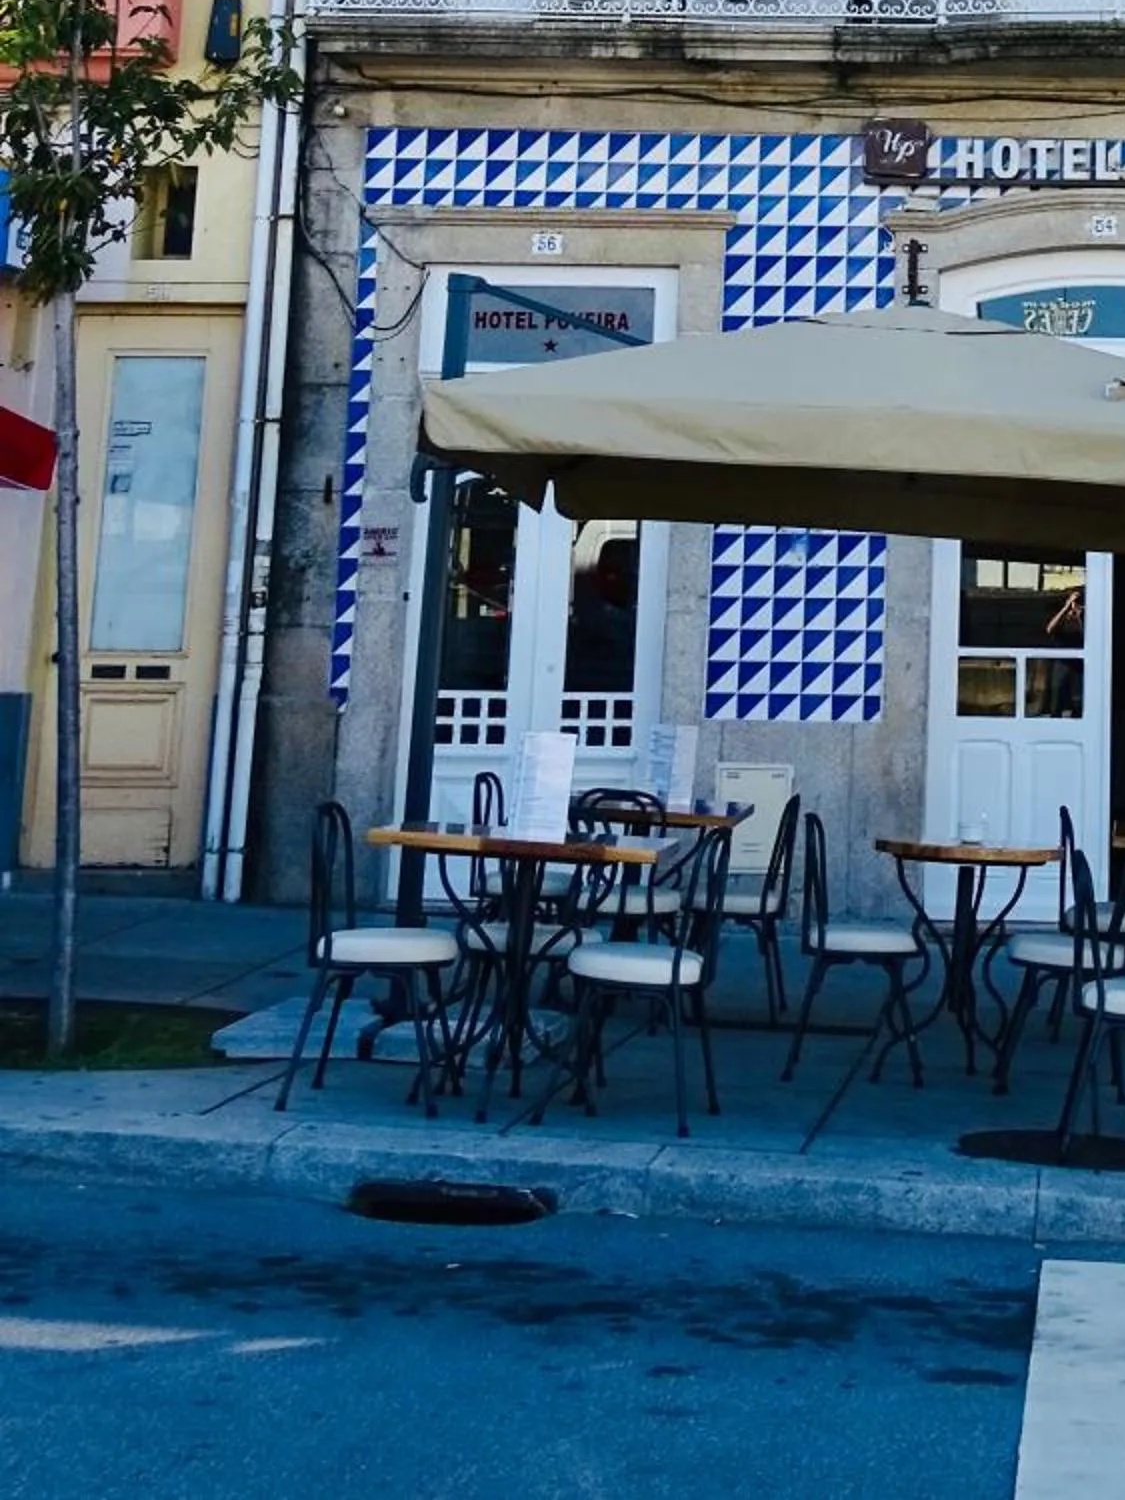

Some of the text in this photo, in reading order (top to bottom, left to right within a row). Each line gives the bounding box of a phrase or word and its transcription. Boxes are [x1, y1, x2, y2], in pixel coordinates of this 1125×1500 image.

[956, 137, 1121, 181] HOTEL
[537, 235, 557, 251] 56
[475, 311, 539, 330] HOTEL
